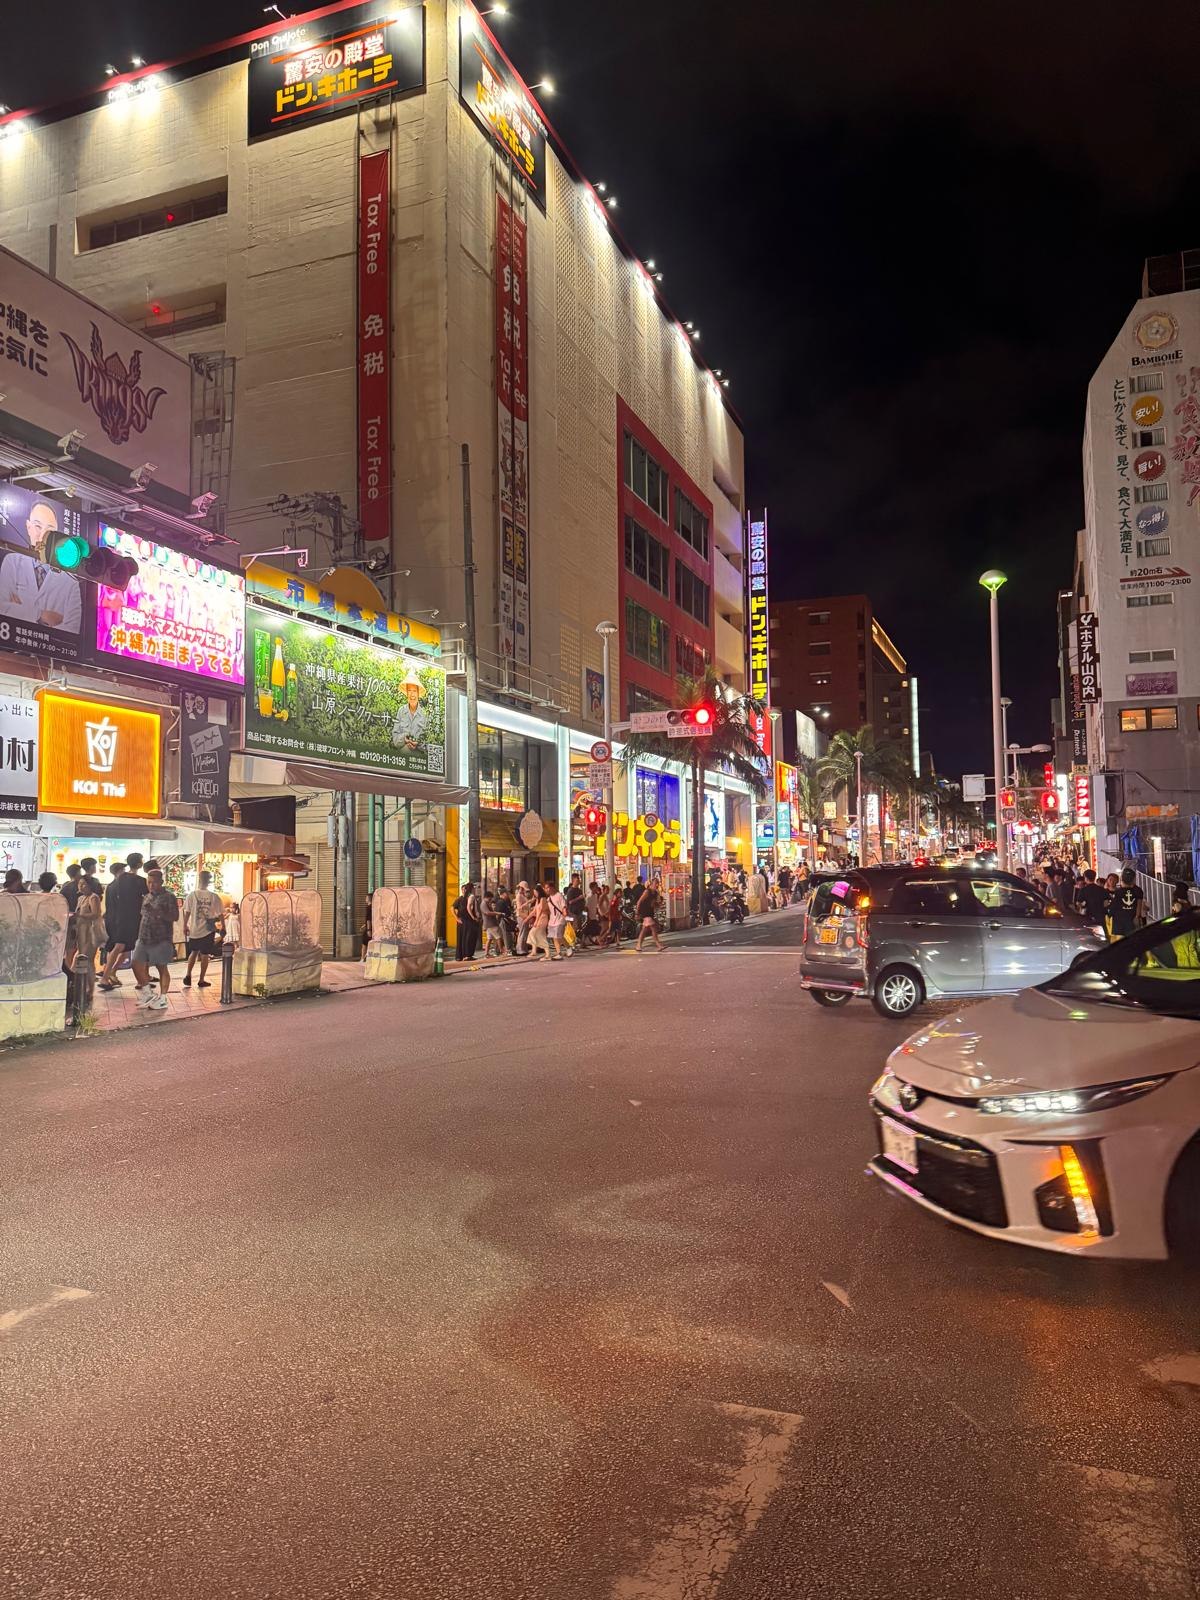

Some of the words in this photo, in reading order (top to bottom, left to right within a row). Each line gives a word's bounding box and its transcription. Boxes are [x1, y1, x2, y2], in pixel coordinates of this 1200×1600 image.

[251, 40, 270, 52] Don
[284, 34, 385, 85] 驚安の殿堂
[366, 193, 382, 227] Tax
[366, 232, 381, 274] Free
[363, 313, 385, 377] 免税
[366, 416, 382, 450] Tax
[367, 455, 382, 501] Free
[750, 521, 766, 591] 驚安の殿堂
[1079, 629, 1096, 698] ホテル山の内
[755, 714, 764, 731] ax
[1073, 711, 1085, 719] 3F
[0, 735, 37, 773] 村
[73, 780, 98, 796] KOI
[102, 782, 126, 798] Thé
[1077, 778, 1090, 824] カラオケ
[1, 841, 21, 849] CAFE
